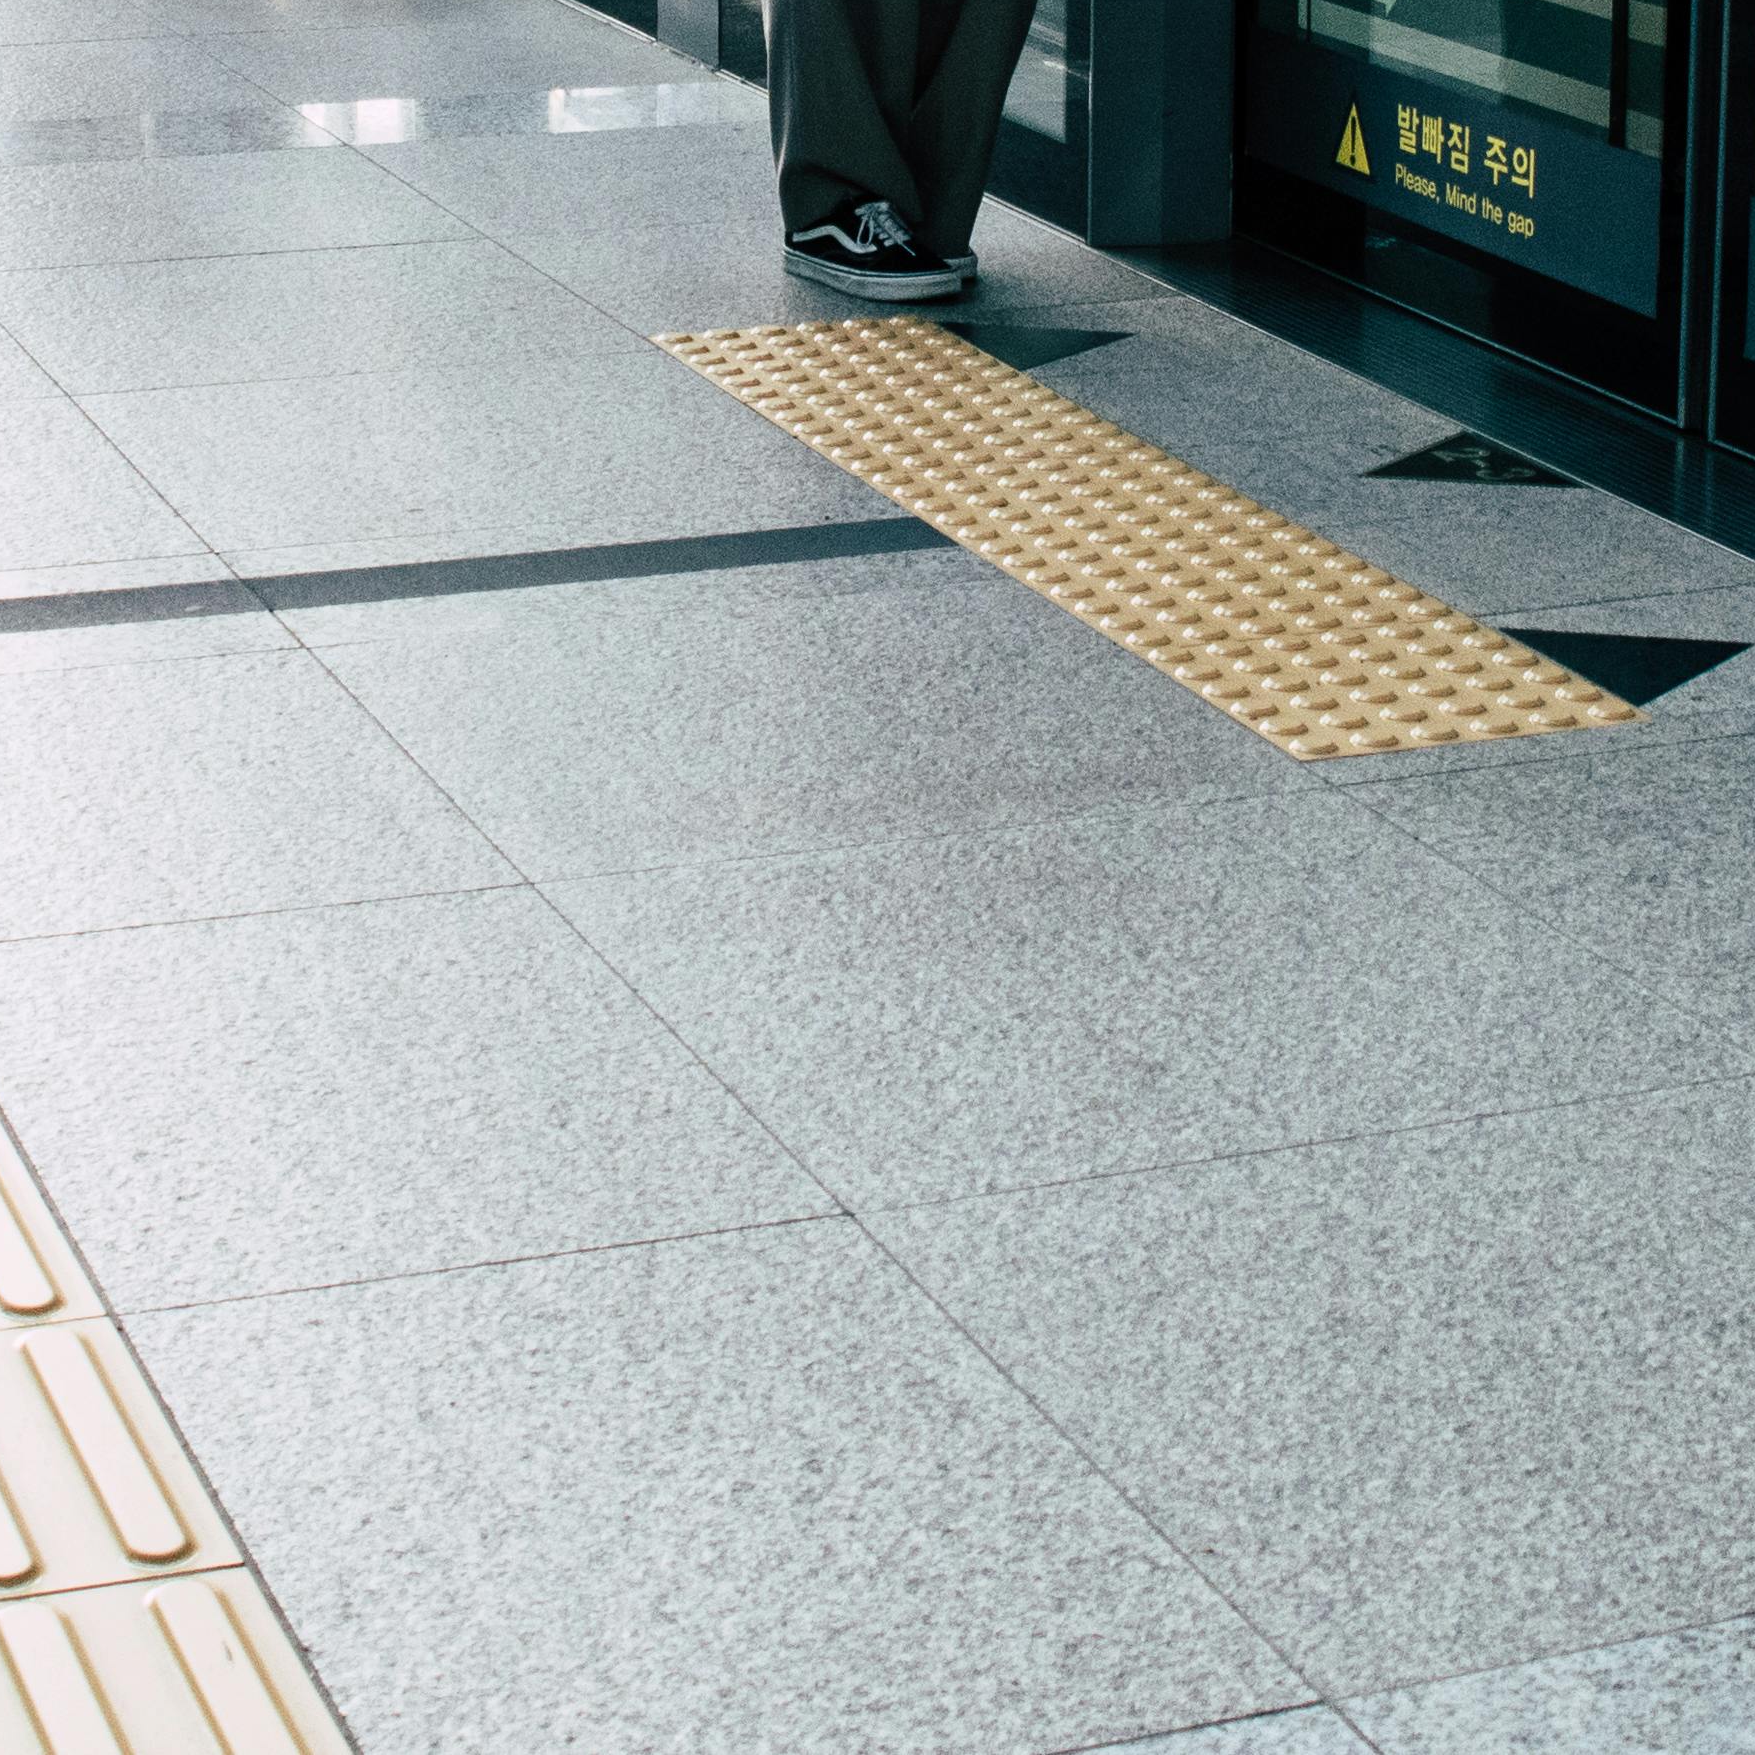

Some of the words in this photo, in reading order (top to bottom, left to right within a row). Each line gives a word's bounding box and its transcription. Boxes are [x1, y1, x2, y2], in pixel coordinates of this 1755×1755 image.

[1397, 103, 1471, 174] 발빠짐
[1483, 134, 1536, 200] 주의
[1395, 163, 1440, 205] Please,
[1445, 182, 1477, 215] Mind
[1482, 196, 1503, 225] the
[1507, 210, 1535, 240] gap
